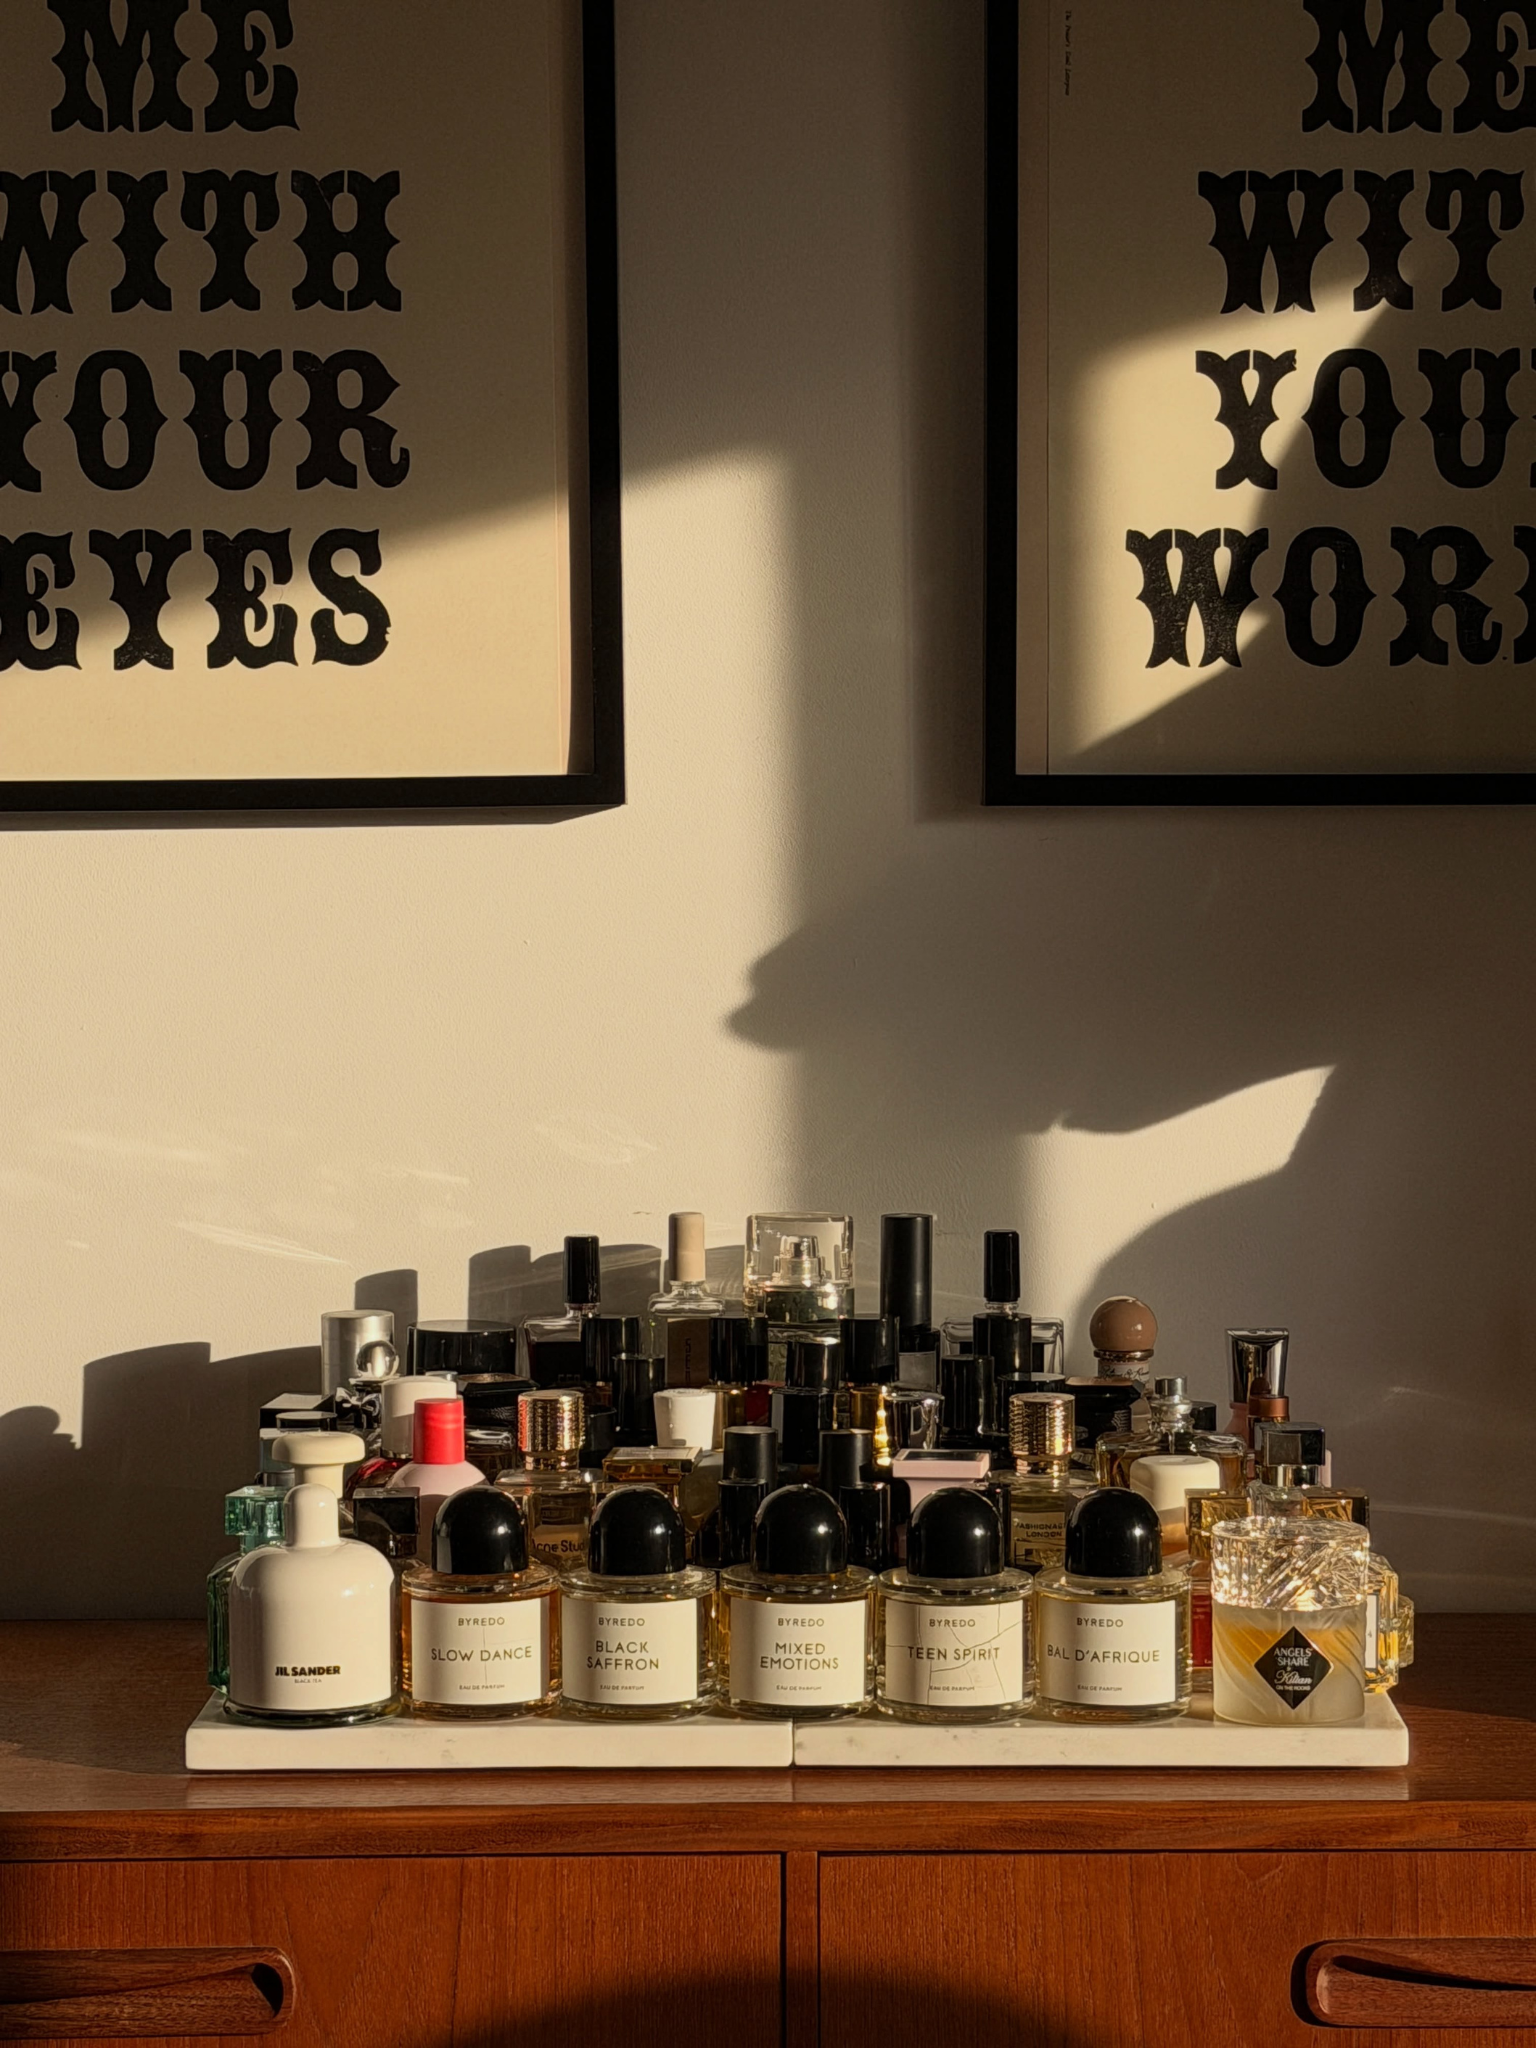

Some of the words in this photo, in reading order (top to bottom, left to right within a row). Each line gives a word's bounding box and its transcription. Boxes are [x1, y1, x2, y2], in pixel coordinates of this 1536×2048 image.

[47, 0, 300, 133] ME
[1302, 0, 1536, 133] ME
[0, 170, 402, 314] WITH
[1198, 169, 1536, 314] WIT
[1195, 348, 1536, 490] YOU
[0, 527, 392, 671] EYES
[1125, 526, 1536, 669] WOR
[1025, 1530, 1062, 1538] LONDON
[457, 1616, 506, 1627] BYREDO
[598, 1616, 646, 1628] BYREDO
[777, 1616, 825, 1628] BYREDO
[929, 1617, 976, 1628] BYREDO
[1077, 1617, 1124, 1628] BYREDO
[430, 1647, 475, 1662] SLOW
[479, 1645, 533, 1662] DANCE
[595, 1640, 649, 1655] BLACK
[775, 1641, 826, 1656] MIXED
[908, 1645, 949, 1661] TEEN
[952, 1646, 1000, 1662] SPIRIT
[1046, 1644, 1070, 1659] BAL
[1074, 1648, 1161, 1664] D'AFRIQUE
[586, 1655, 660, 1671] SAFFRON
[759, 1655, 840, 1671] EMOTIONS
[1277, 1657, 1309, 1666] SHARE
[275, 1666, 290, 1676] JIL
[291, 1665, 341, 1677] SANDER
[1274, 1670, 1313, 1684] Kilian
